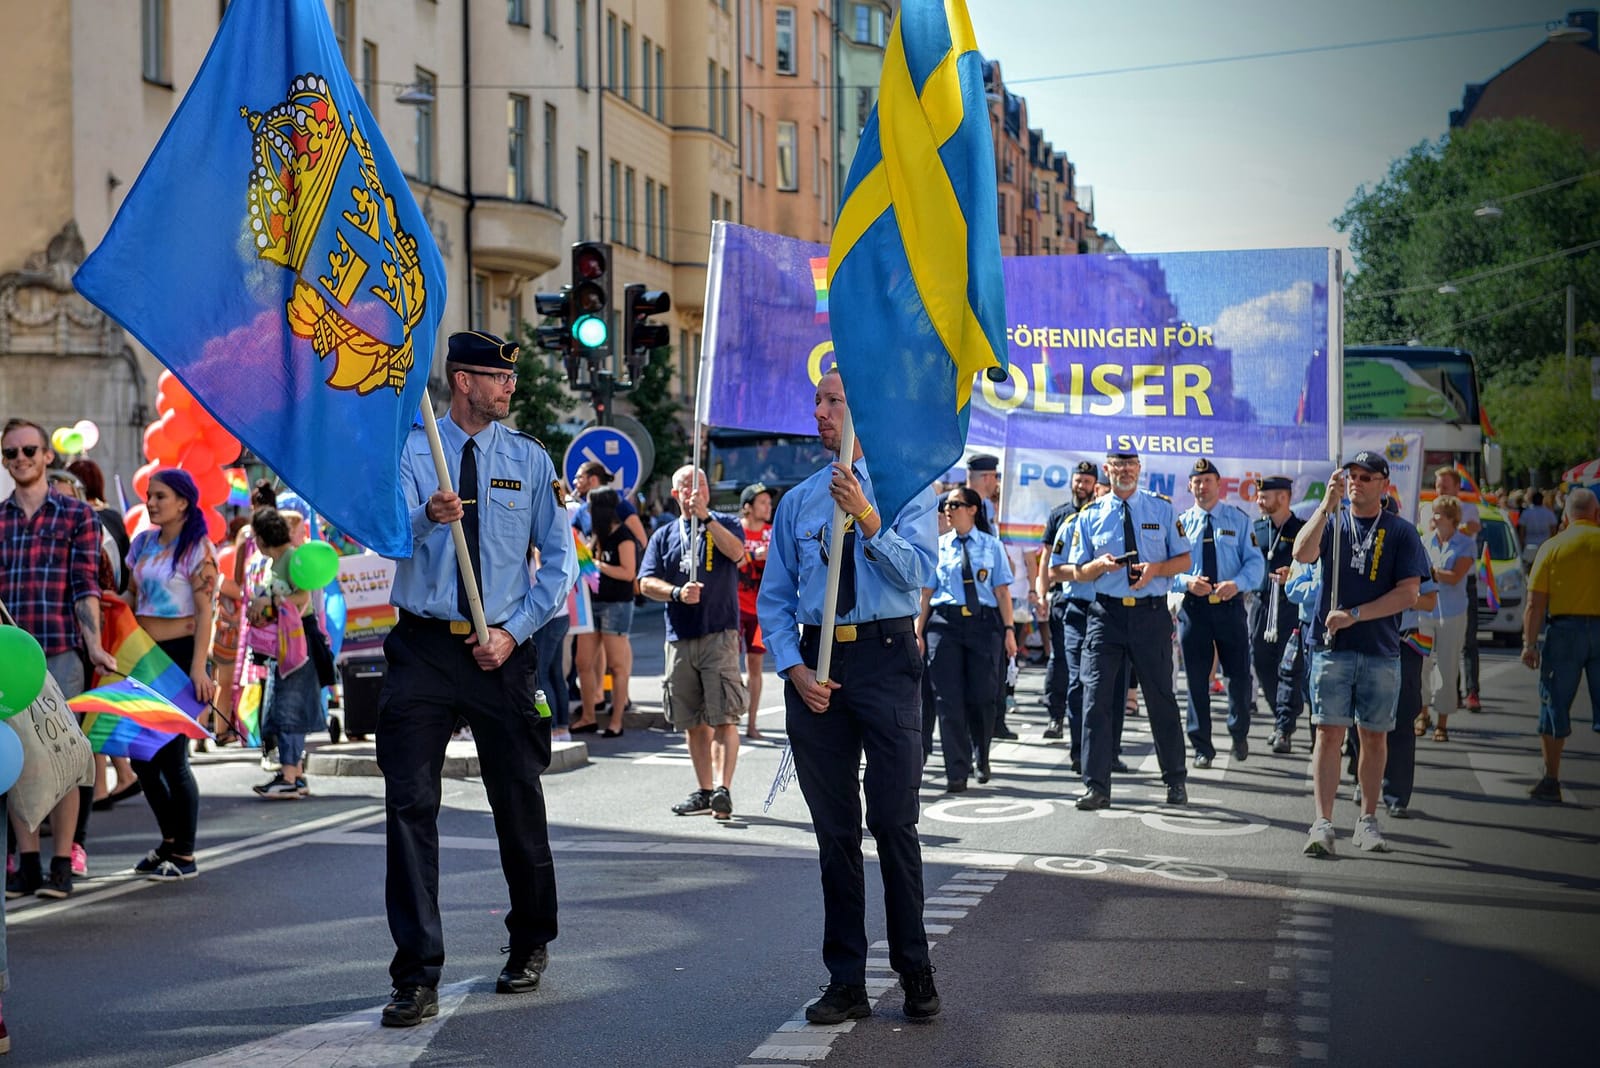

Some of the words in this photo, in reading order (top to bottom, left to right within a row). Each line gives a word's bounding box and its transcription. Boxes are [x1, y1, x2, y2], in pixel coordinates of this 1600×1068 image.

[1164, 322, 1213, 348] FÖR
[973, 362, 1214, 417] OLISER
[1117, 434, 1215, 454] SVERIGE
[492, 480, 520, 489] POLIS
[361, 570, 386, 581] SLUT
